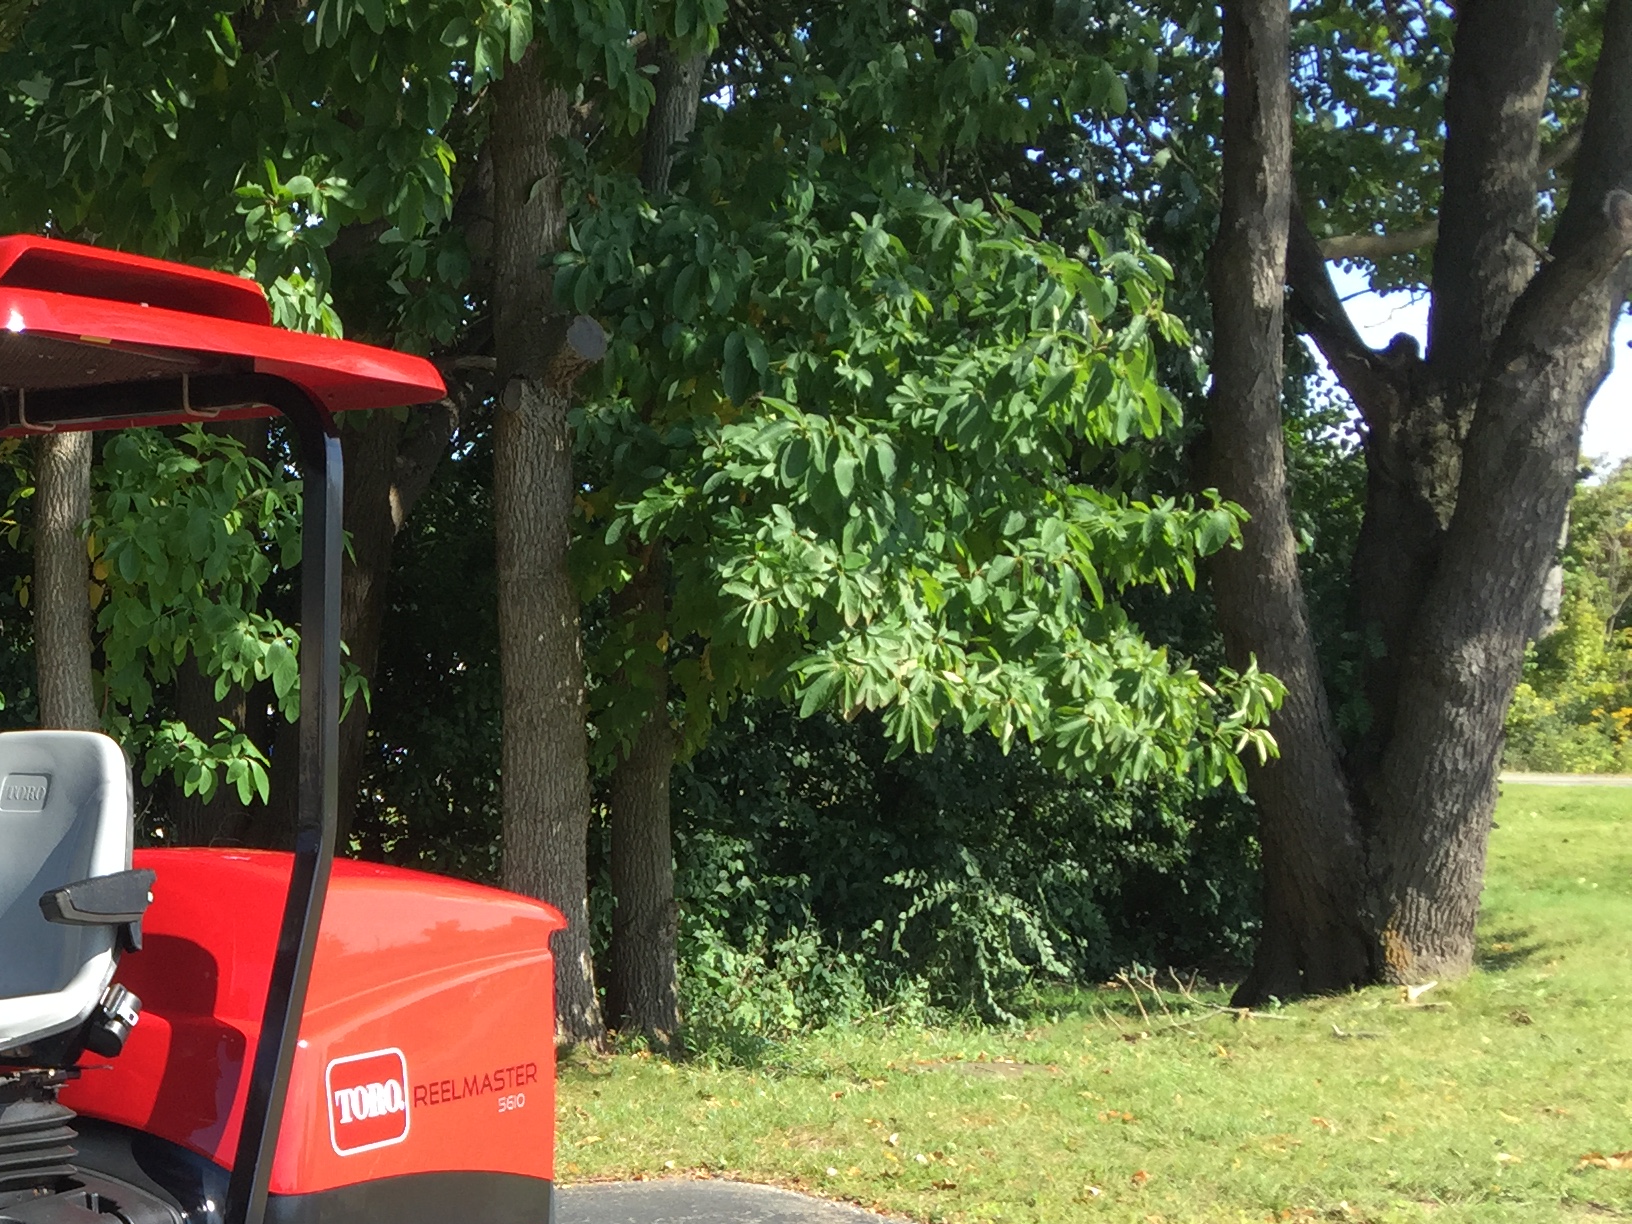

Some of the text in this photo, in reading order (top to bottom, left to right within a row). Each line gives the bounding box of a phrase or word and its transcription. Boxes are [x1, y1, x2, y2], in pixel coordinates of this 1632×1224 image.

[6, 785, 47, 801] TORO
[334, 1079, 403, 1124] TORO
[413, 1062, 538, 1108] REELMASTER
[497, 1092, 526, 1113] 5610
